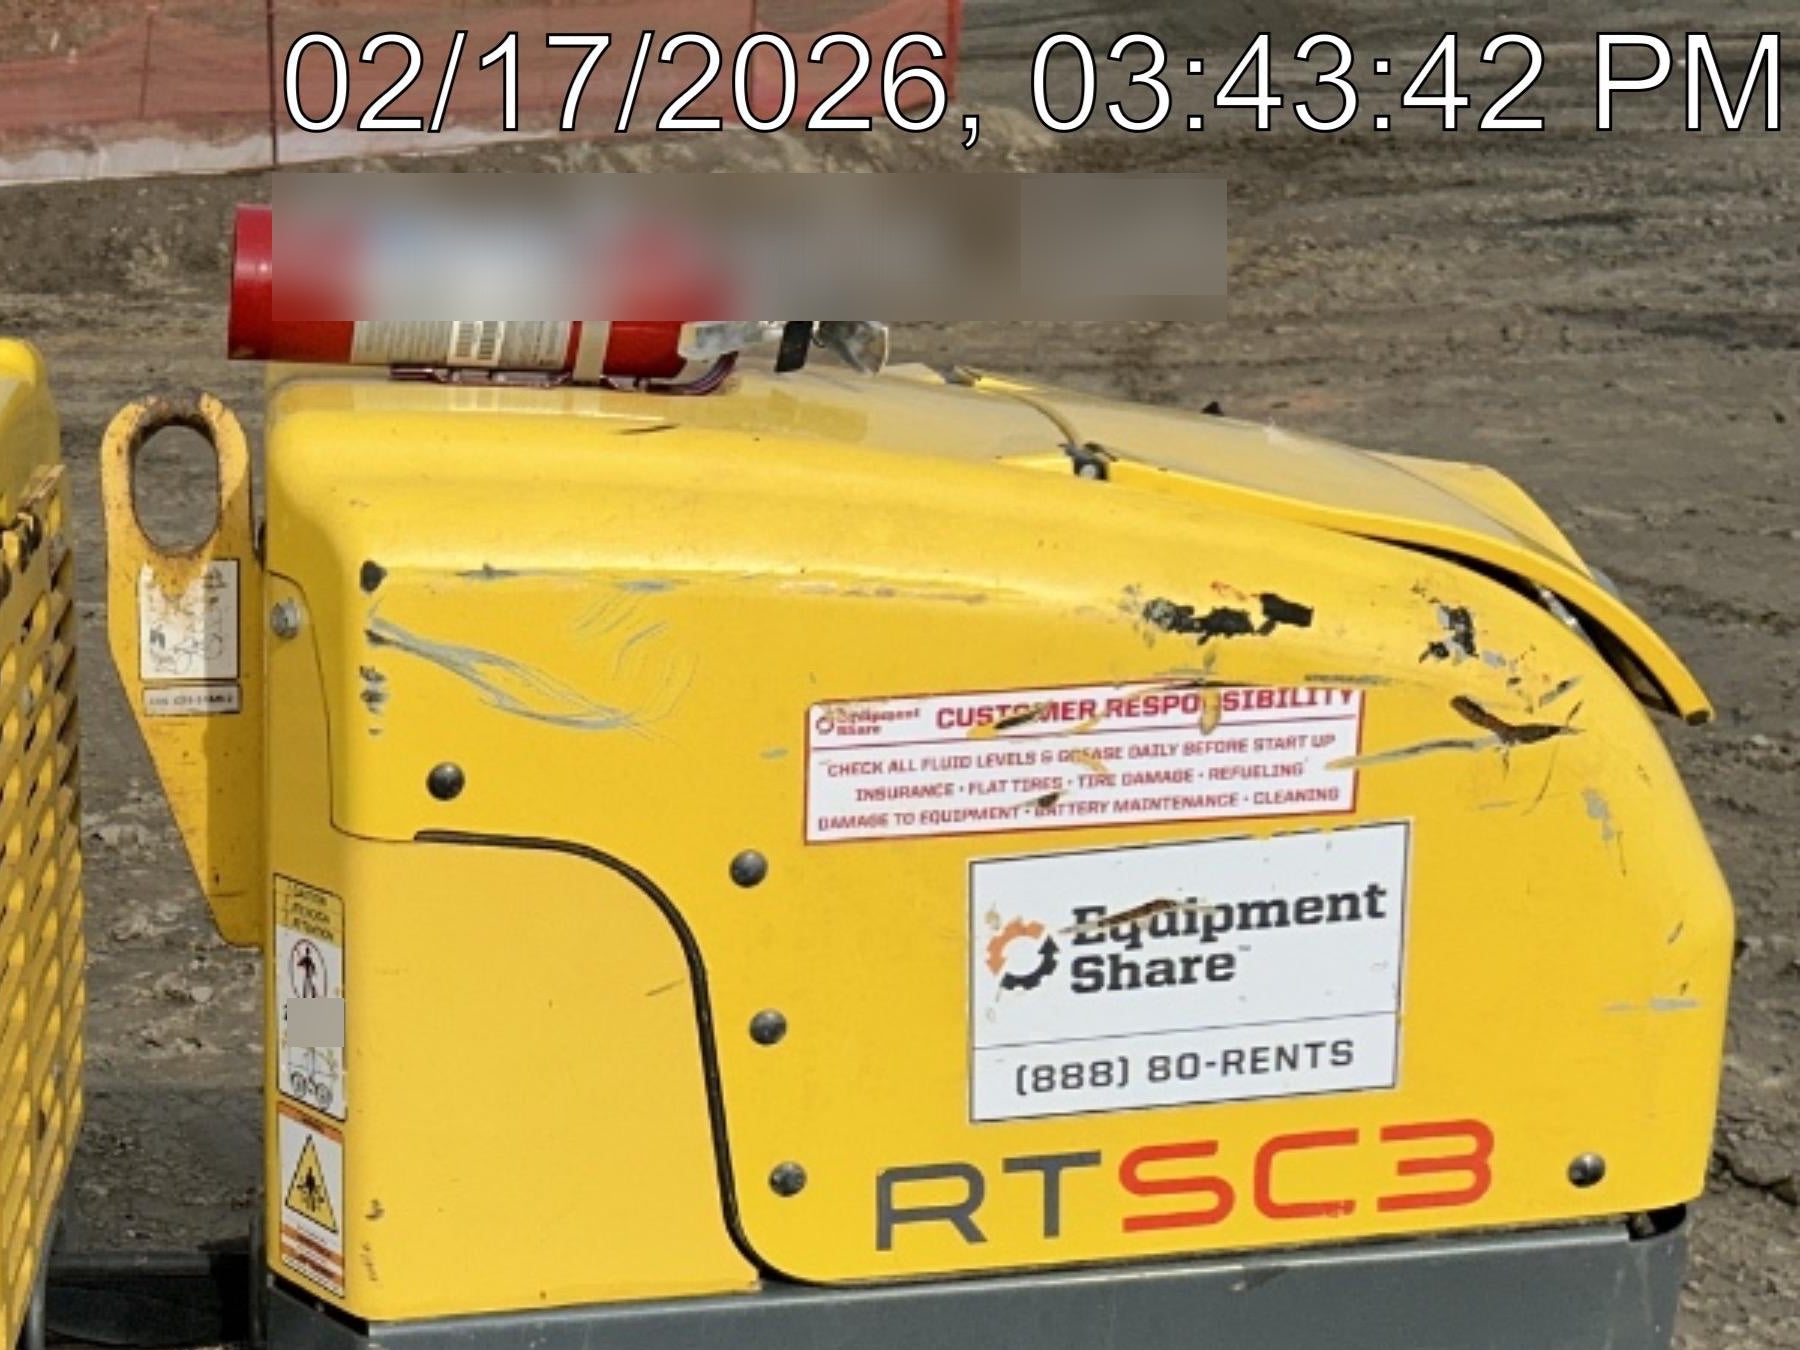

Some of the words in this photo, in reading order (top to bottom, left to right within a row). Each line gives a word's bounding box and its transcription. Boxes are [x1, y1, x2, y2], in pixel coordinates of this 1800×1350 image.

[1104, 686, 1354, 719] RESPOSIBILITY
[827, 761, 883, 778] CHECK
[888, 757, 918, 773] ALL
[921, 754, 972, 772] FLUID
[976, 750, 1037, 769] LEVELS
[1127, 742, 1180, 760] DAILY
[1182, 737, 1248, 756] BEFORE
[1253, 734, 1309, 751] START
[1310, 734, 1336, 749] UP
[855, 781, 956, 802] INSURANCE
[968, 779, 1009, 796] FLAT
[1011, 776, 1063, 792] TIRES
[1077, 771, 1117, 789] TIRE
[1121, 767, 1195, 787] DAMAGE
[1208, 762, 1305, 781] REFUELING
[818, 810, 890, 832] DAMAGE
[894, 810, 916, 826] TO
[919, 804, 1020, 826] EQUIPMENT
[1113, 792, 1238, 815] MAINTENANCE
[1253, 786, 1340, 806] CLEANING
[1071, 882, 1388, 952] Equipment
[1070, 952, 1236, 994] Share
[1015, 1056, 1129, 1096] (888)
[1146, 1039, 1355, 1084] 80-RENTS
[874, 1118, 1496, 1252] RTSC3
